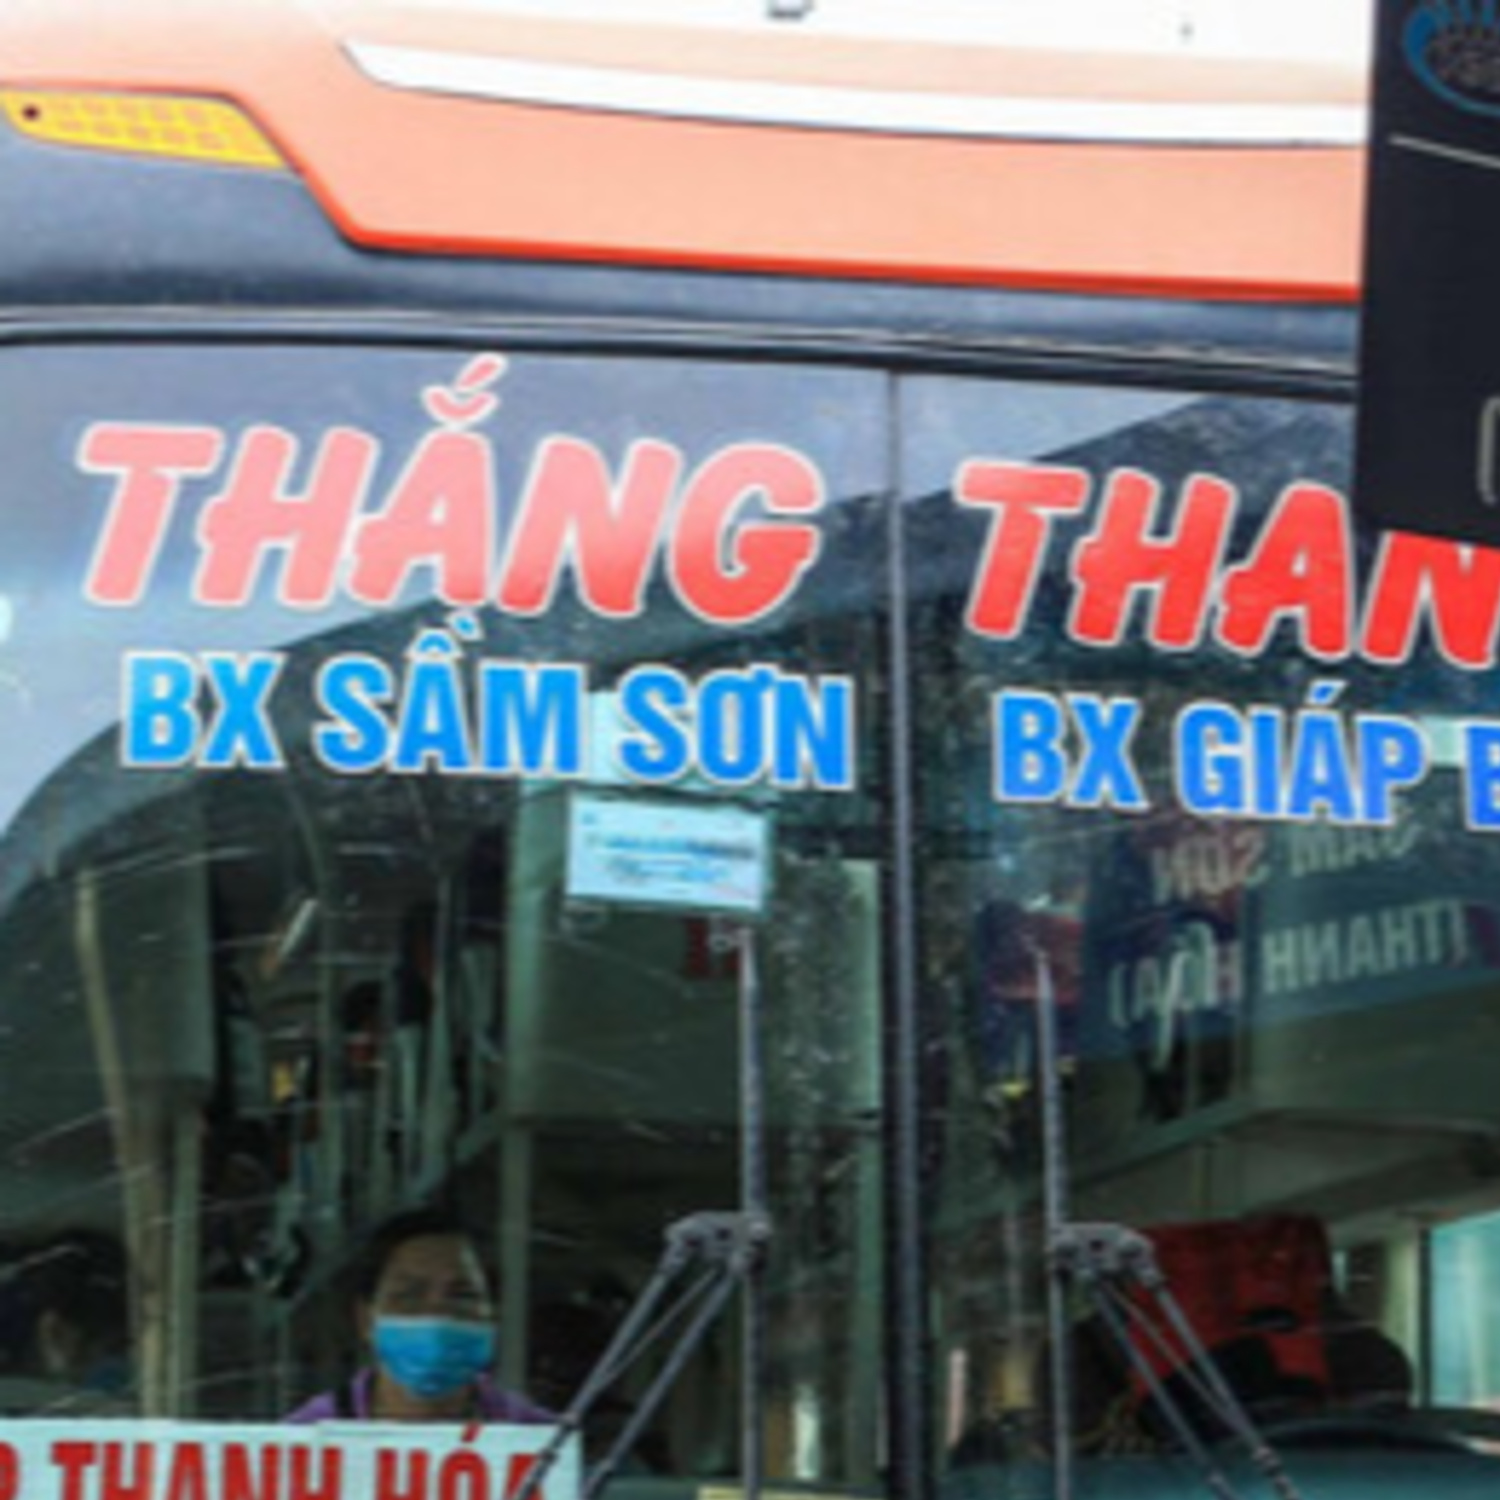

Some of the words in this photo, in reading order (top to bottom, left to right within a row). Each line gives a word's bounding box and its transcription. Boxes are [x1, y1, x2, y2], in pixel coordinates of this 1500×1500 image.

[76, 352, 824, 624] THẮNG
[121, 648, 285, 770] BX
[313, 610, 586, 779] SẦM
[617, 661, 855, 790] SƠN
[993, 688, 1148, 810] BX
[1174, 680, 1430, 826] GIÁP
